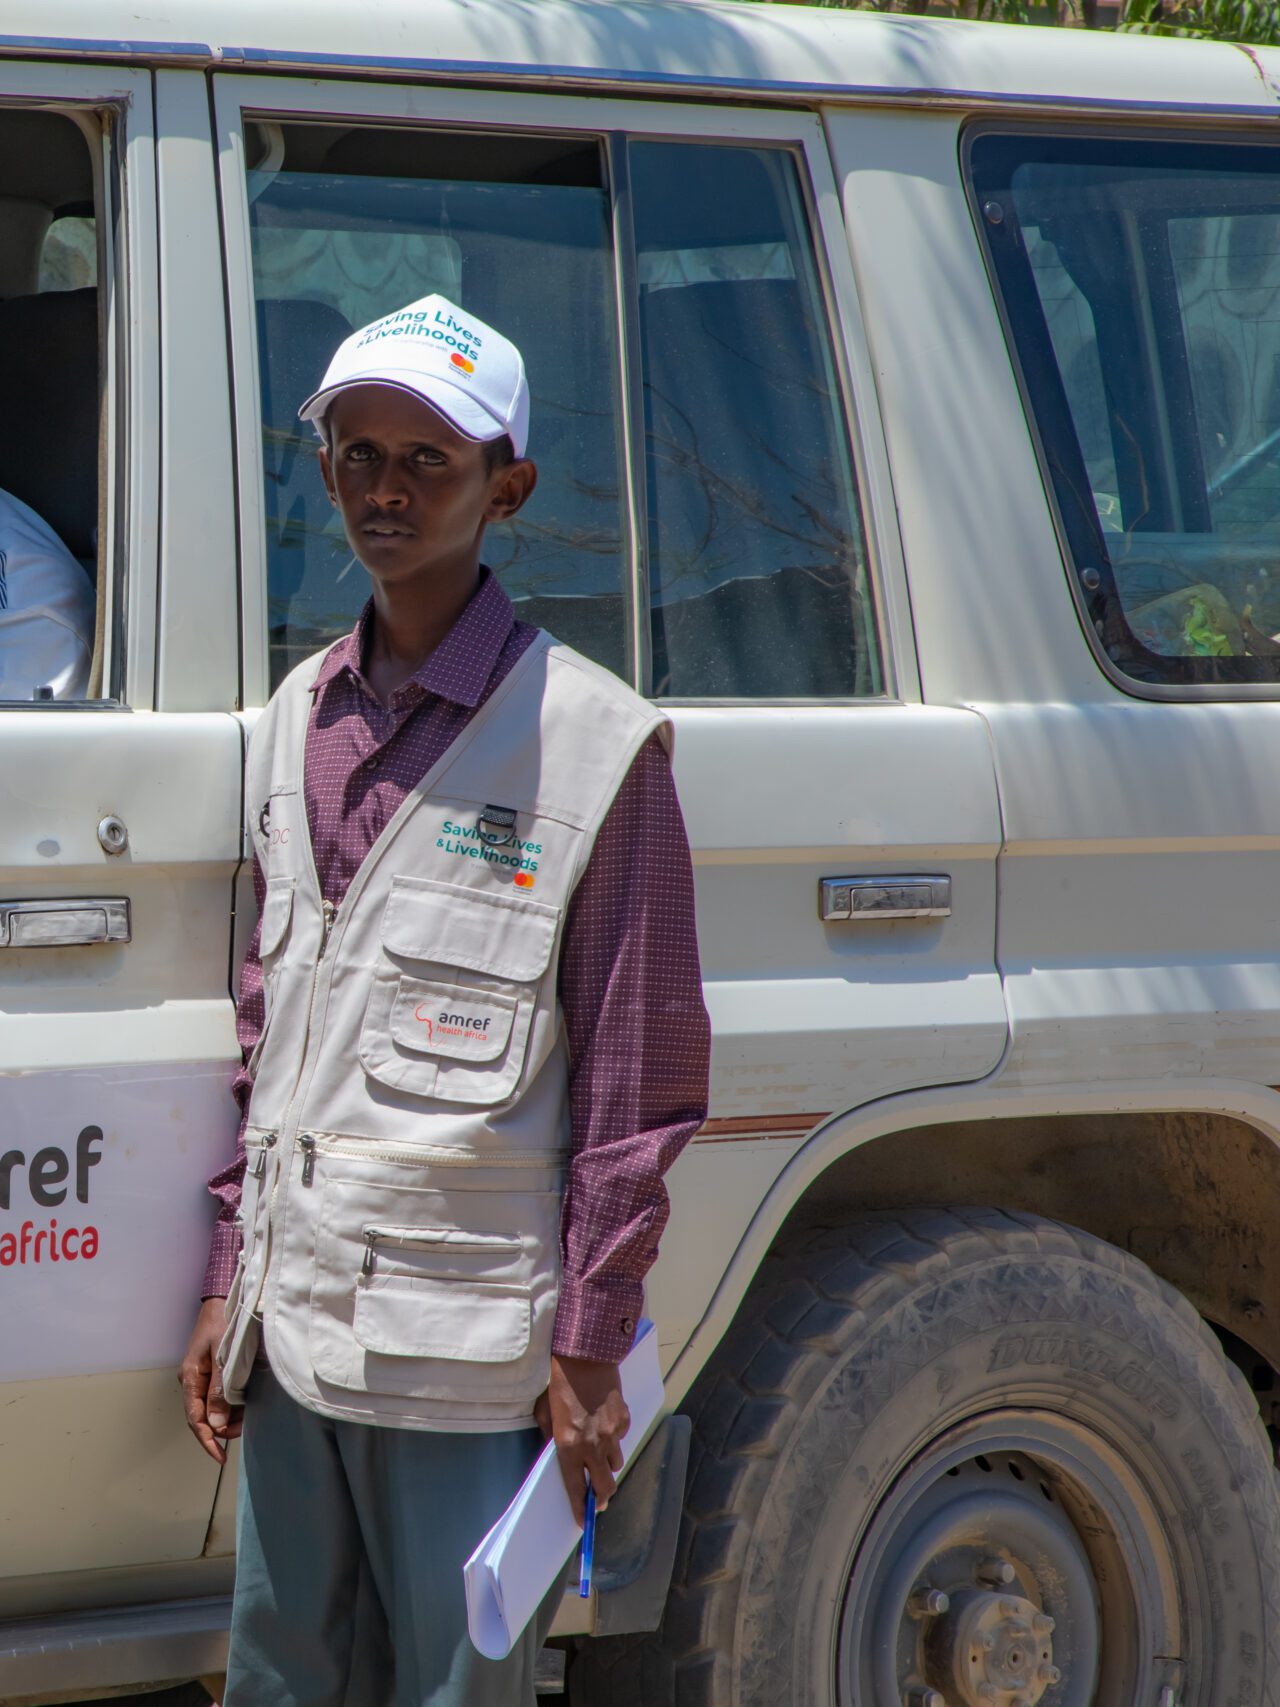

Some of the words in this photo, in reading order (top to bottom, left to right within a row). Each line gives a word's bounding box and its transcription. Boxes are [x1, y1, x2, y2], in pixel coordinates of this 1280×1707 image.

[364, 312, 428, 337] Saving
[434, 310, 482, 347] Lives
[436, 1024, 463, 1036] health
[464, 1030, 487, 1041] africa
[438, 1012, 492, 1031] amref
[0, 1218, 99, 1267] africa
[986, 1331, 1181, 1418] DUNLOP
